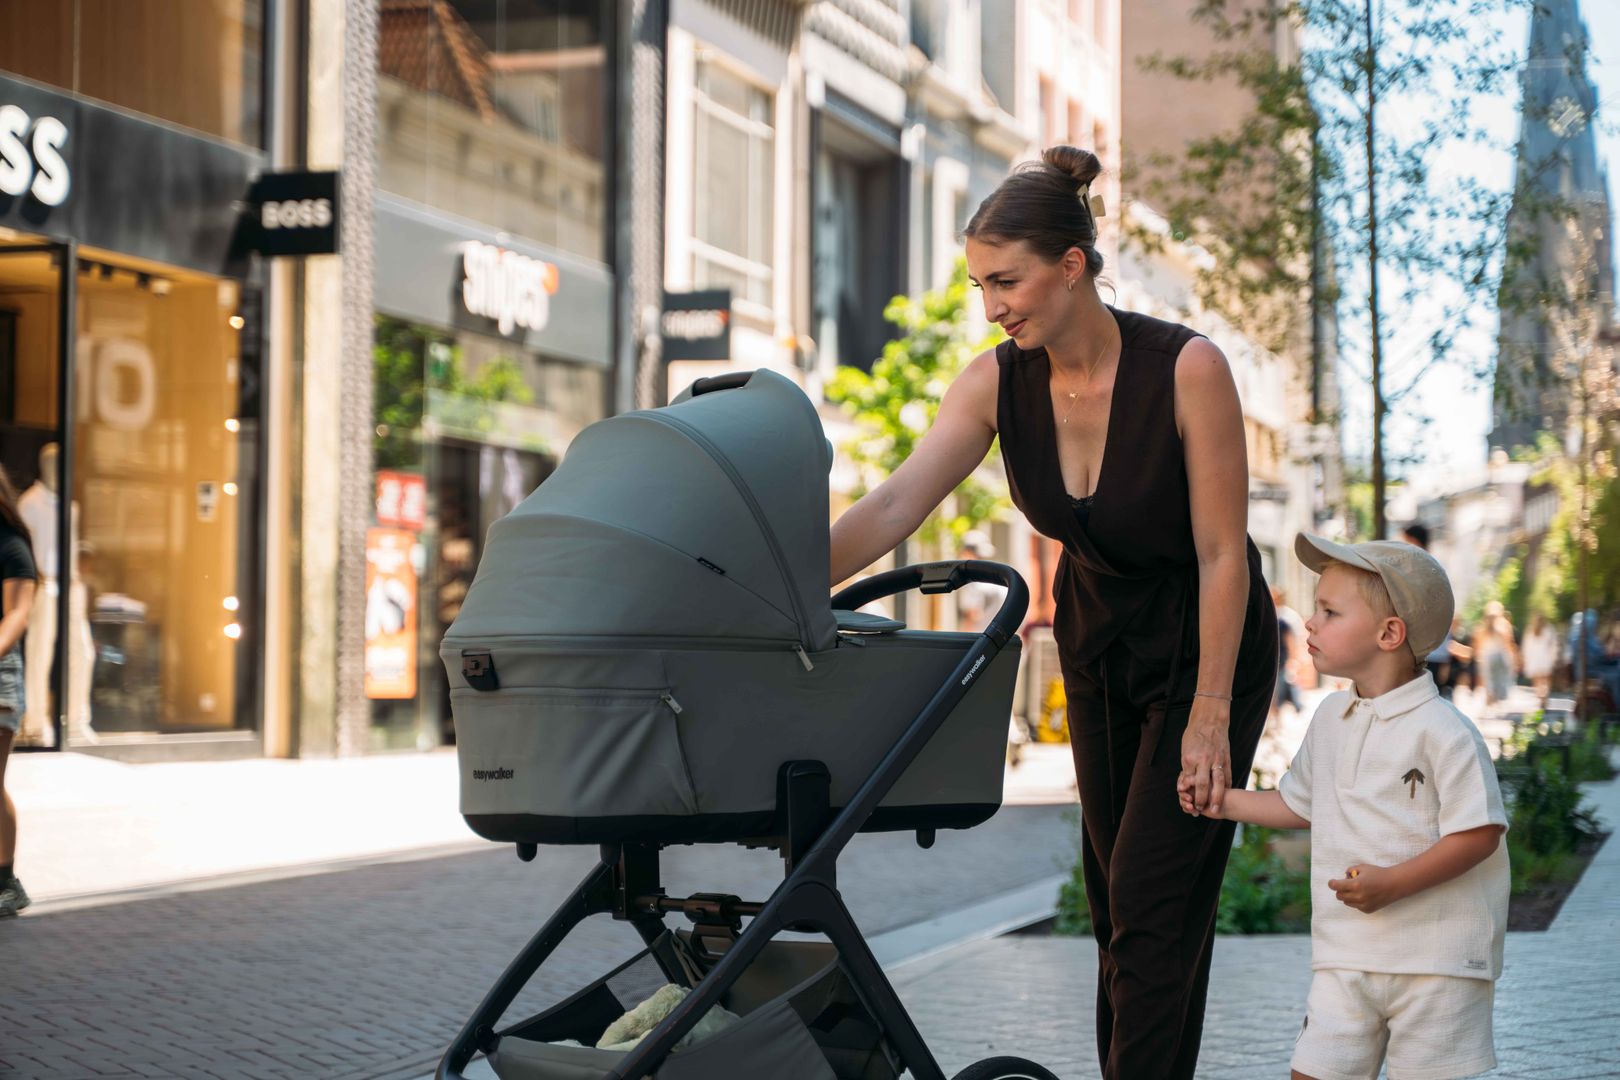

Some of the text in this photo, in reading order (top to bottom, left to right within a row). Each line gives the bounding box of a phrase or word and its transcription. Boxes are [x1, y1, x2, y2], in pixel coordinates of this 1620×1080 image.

[262, 199, 332, 229] BOSS
[962, 654, 986, 686] easywalker
[473, 767, 514, 781] easywalker
